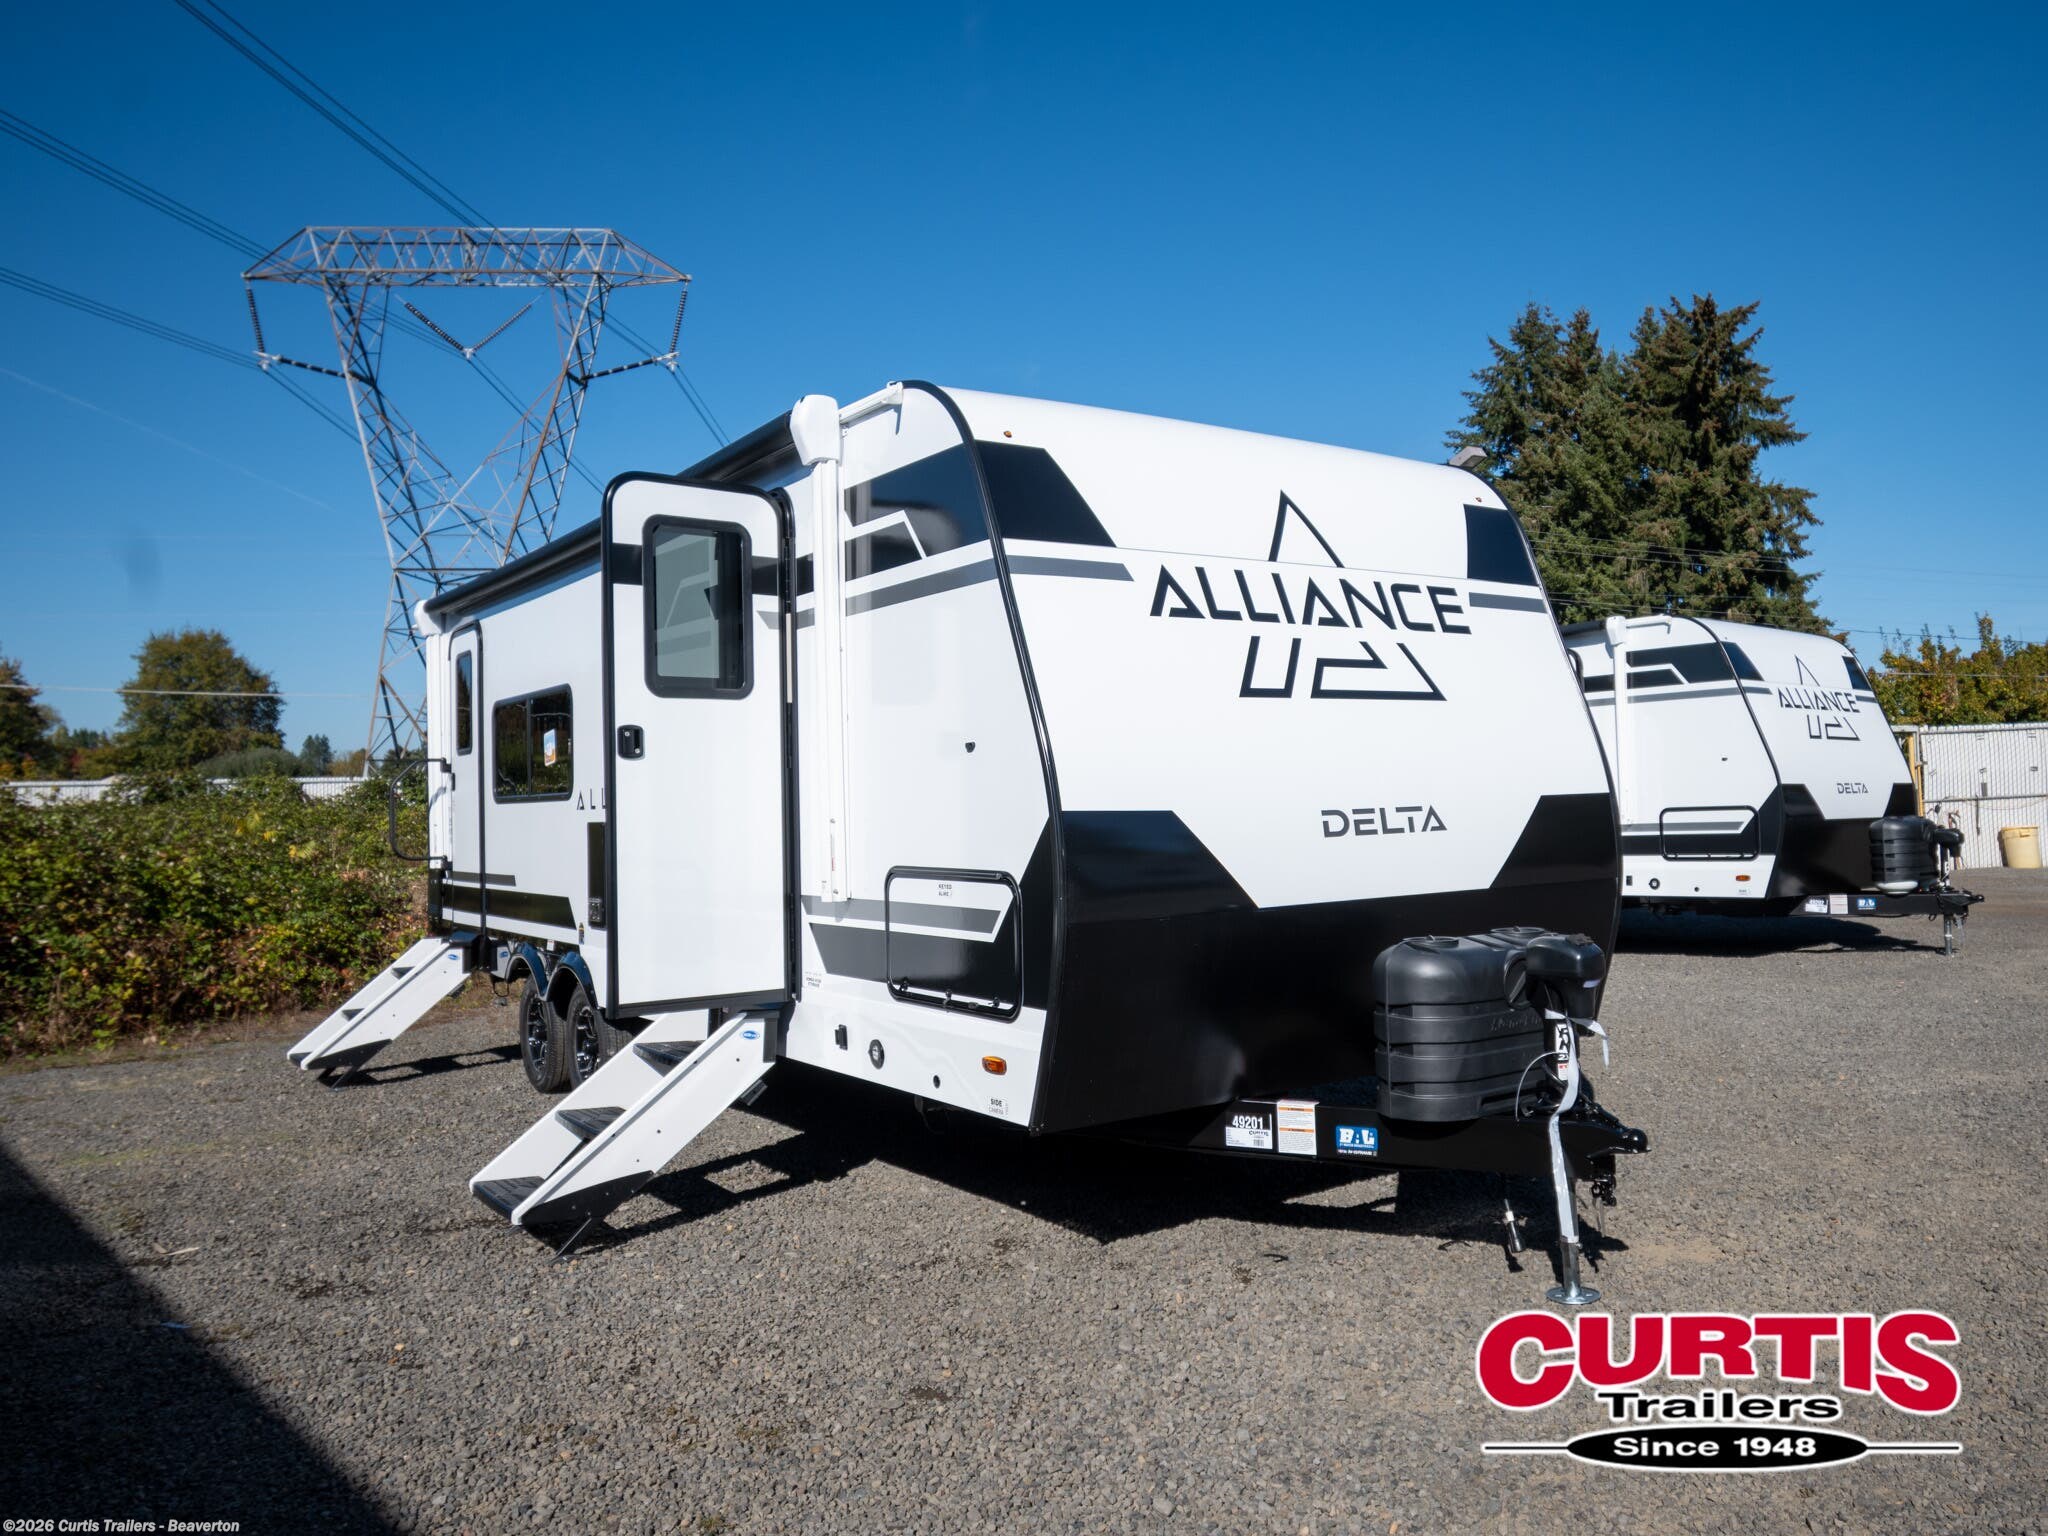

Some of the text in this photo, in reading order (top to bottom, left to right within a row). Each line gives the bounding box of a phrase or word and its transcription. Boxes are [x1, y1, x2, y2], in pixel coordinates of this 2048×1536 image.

[1150, 564, 1472, 635] ALLIANCE
[1778, 687, 1861, 713] ALLIANCE
[1837, 782, 1869, 794] DELTA
[1320, 804, 1448, 838] DELTA
[1232, 1115, 1264, 1130] 49201
